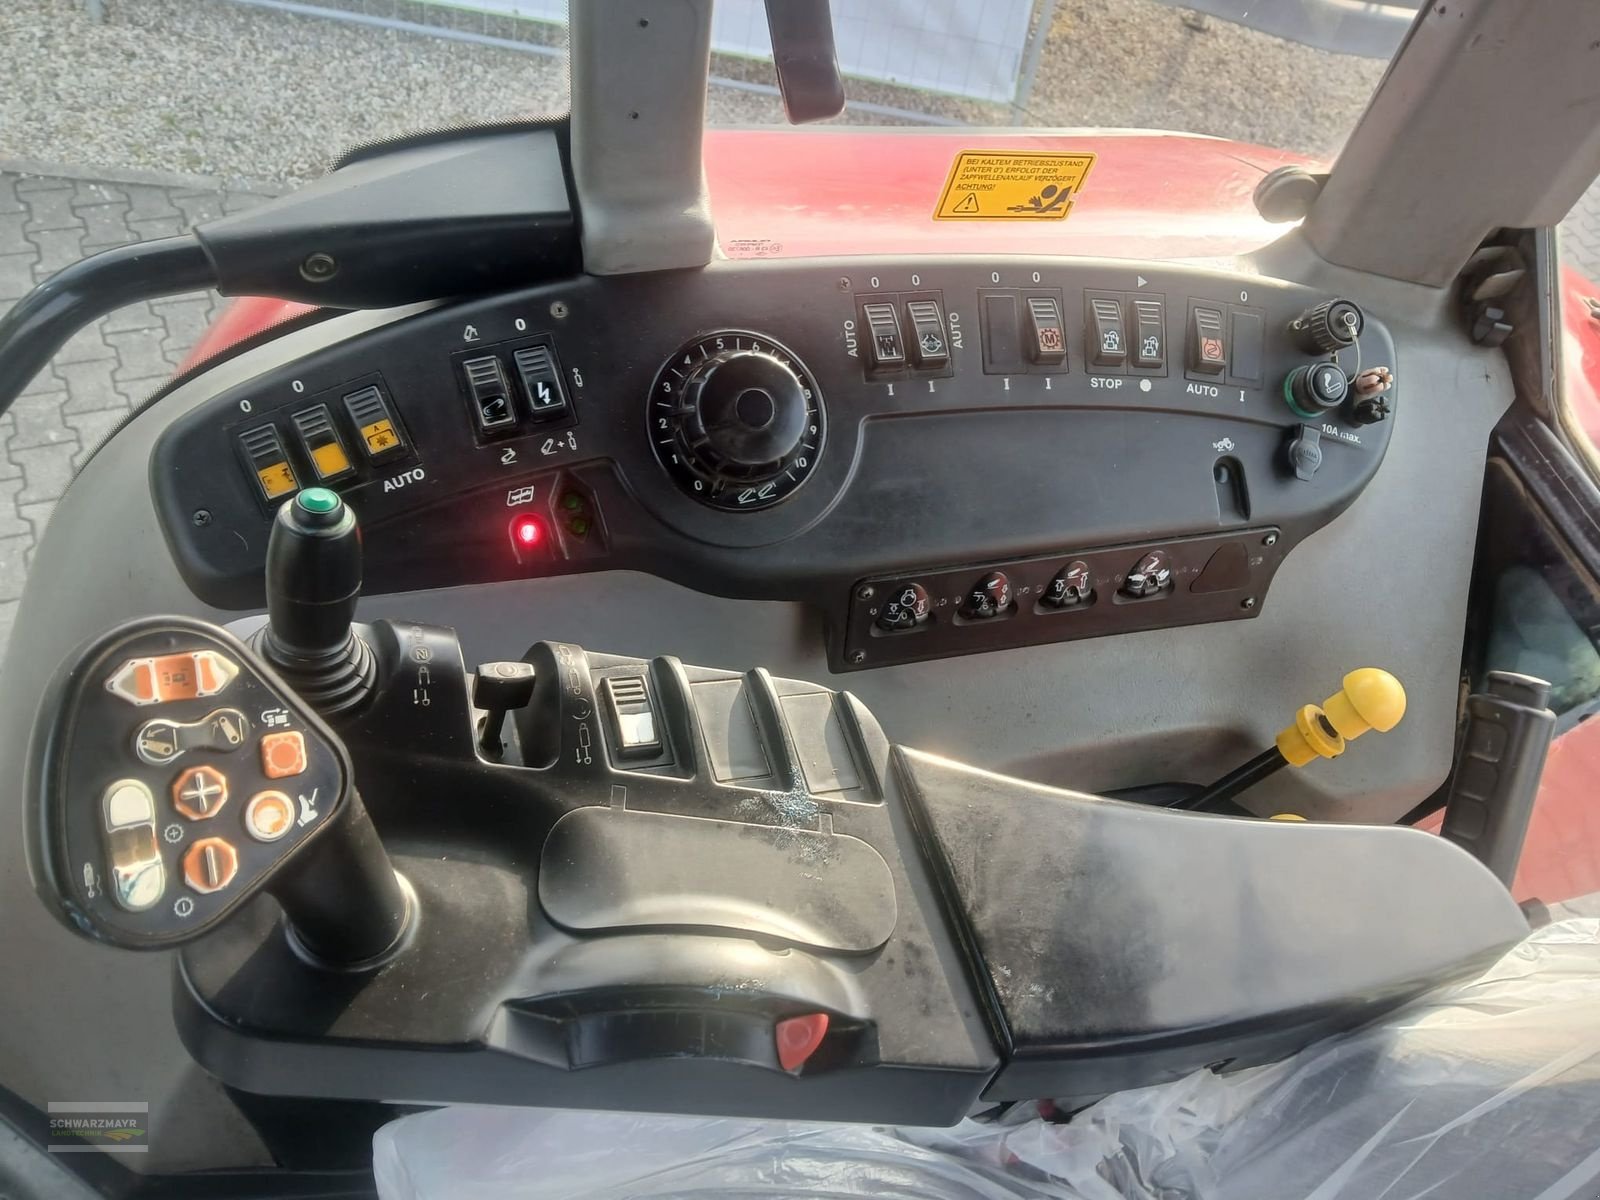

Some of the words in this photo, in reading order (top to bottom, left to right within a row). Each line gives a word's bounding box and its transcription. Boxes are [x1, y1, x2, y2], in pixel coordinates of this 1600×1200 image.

[1012, 159, 1084, 167] BETRIEBSZUSTAND
[955, 183, 996, 191] ACHTUNG!
[949, 312, 964, 349] AUTO
[843, 319, 858, 357] AUTO
[716, 338, 725, 350] 5
[752, 342, 761, 352] 6
[684, 354, 691, 365] 4
[663, 382, 672, 393] 3
[1090, 377, 1123, 389] STOP
[1186, 383, 1219, 398] AUTO
[659, 418, 668, 429] 2
[809, 425, 817, 435] 9
[1322, 424, 1338, 437] 10A
[671, 454, 679, 465] 1
[795, 457, 808, 469] 10
[384, 468, 425, 493] AUTO
[694, 480, 703, 491] 0
